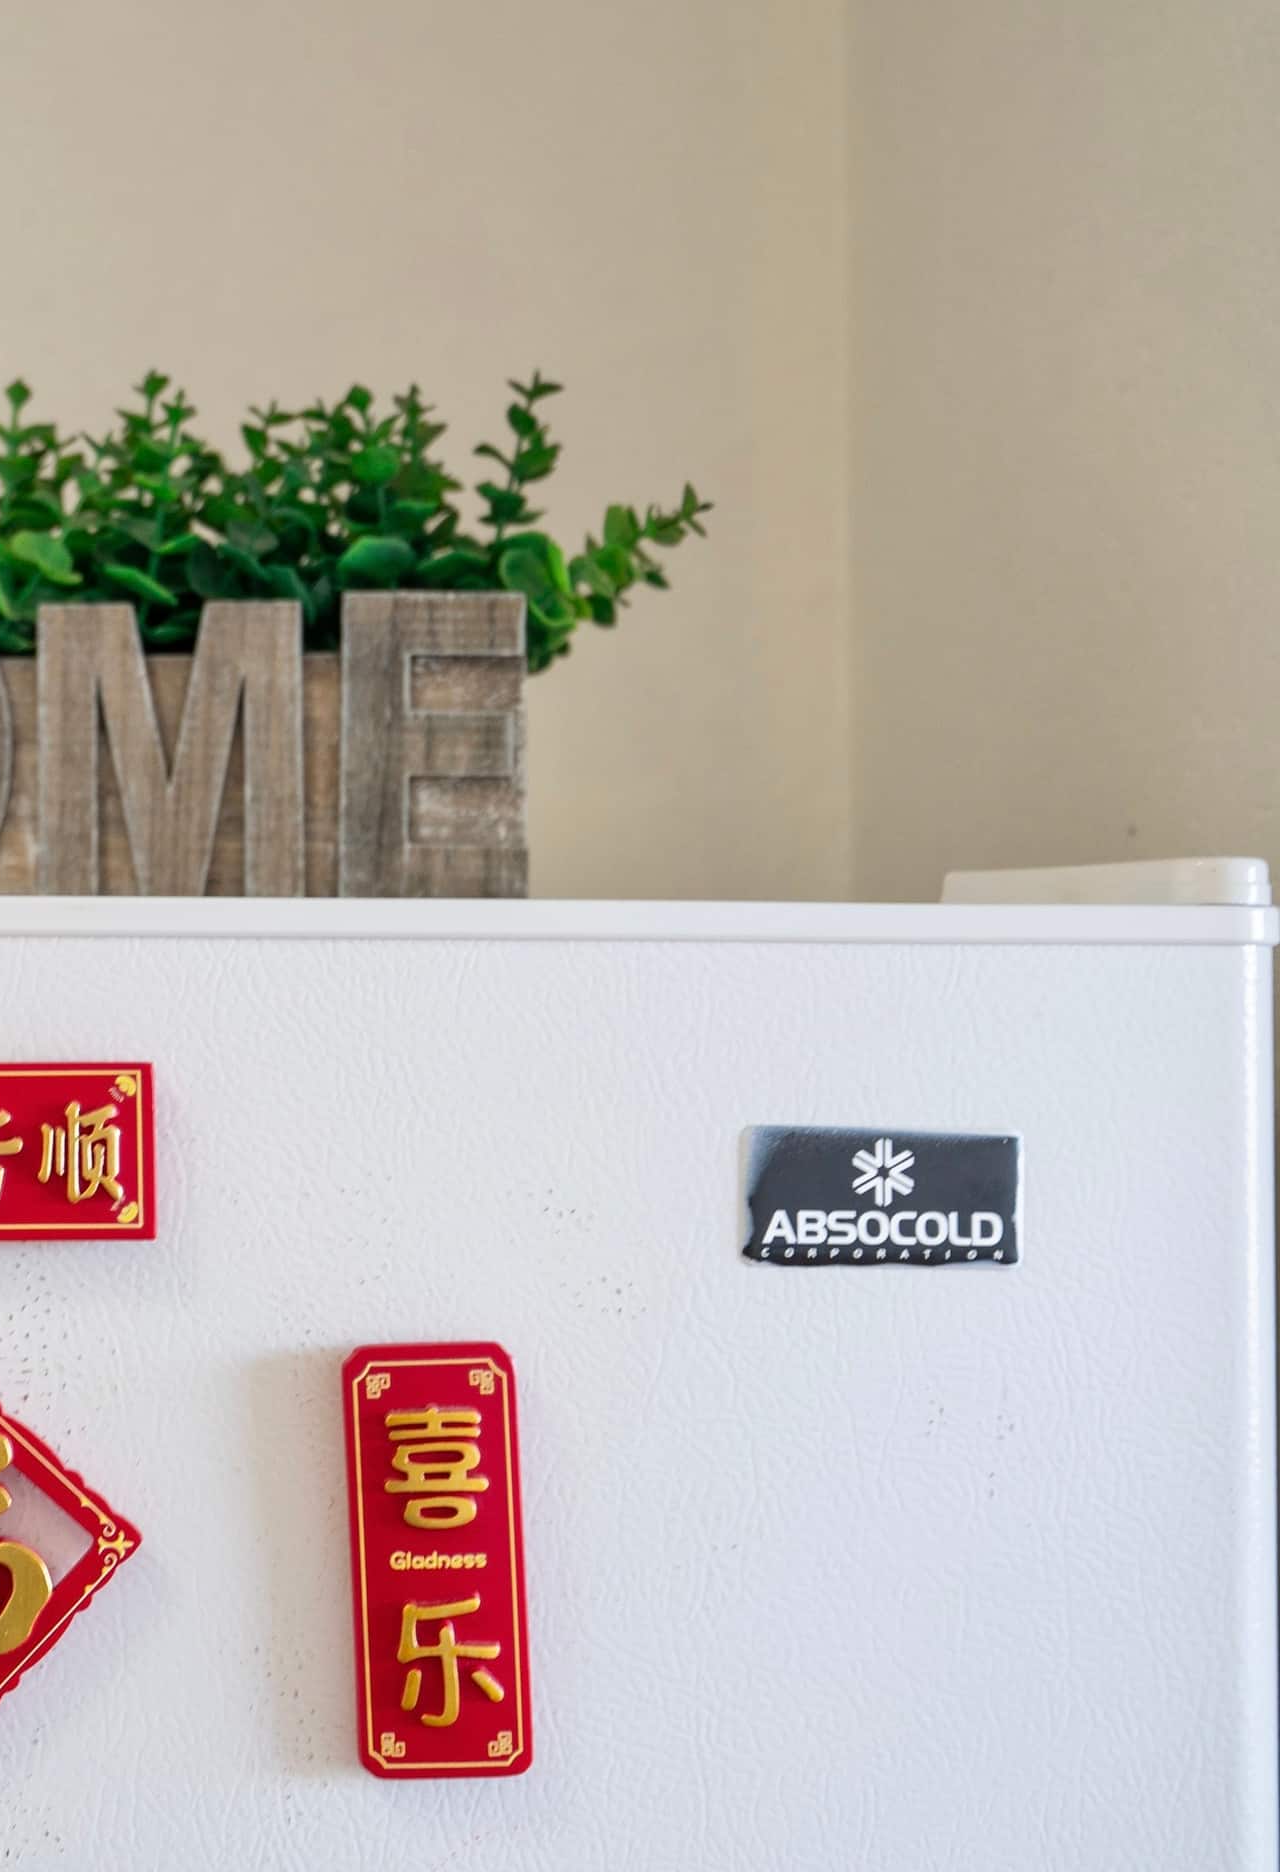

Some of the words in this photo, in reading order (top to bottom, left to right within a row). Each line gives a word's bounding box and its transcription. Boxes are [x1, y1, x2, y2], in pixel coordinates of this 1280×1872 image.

[762, 1209, 1004, 1246] ABSOCOLD
[760, 1248, 1004, 1260] CORPORATION
[389, 1551, 488, 1571] Gladness
